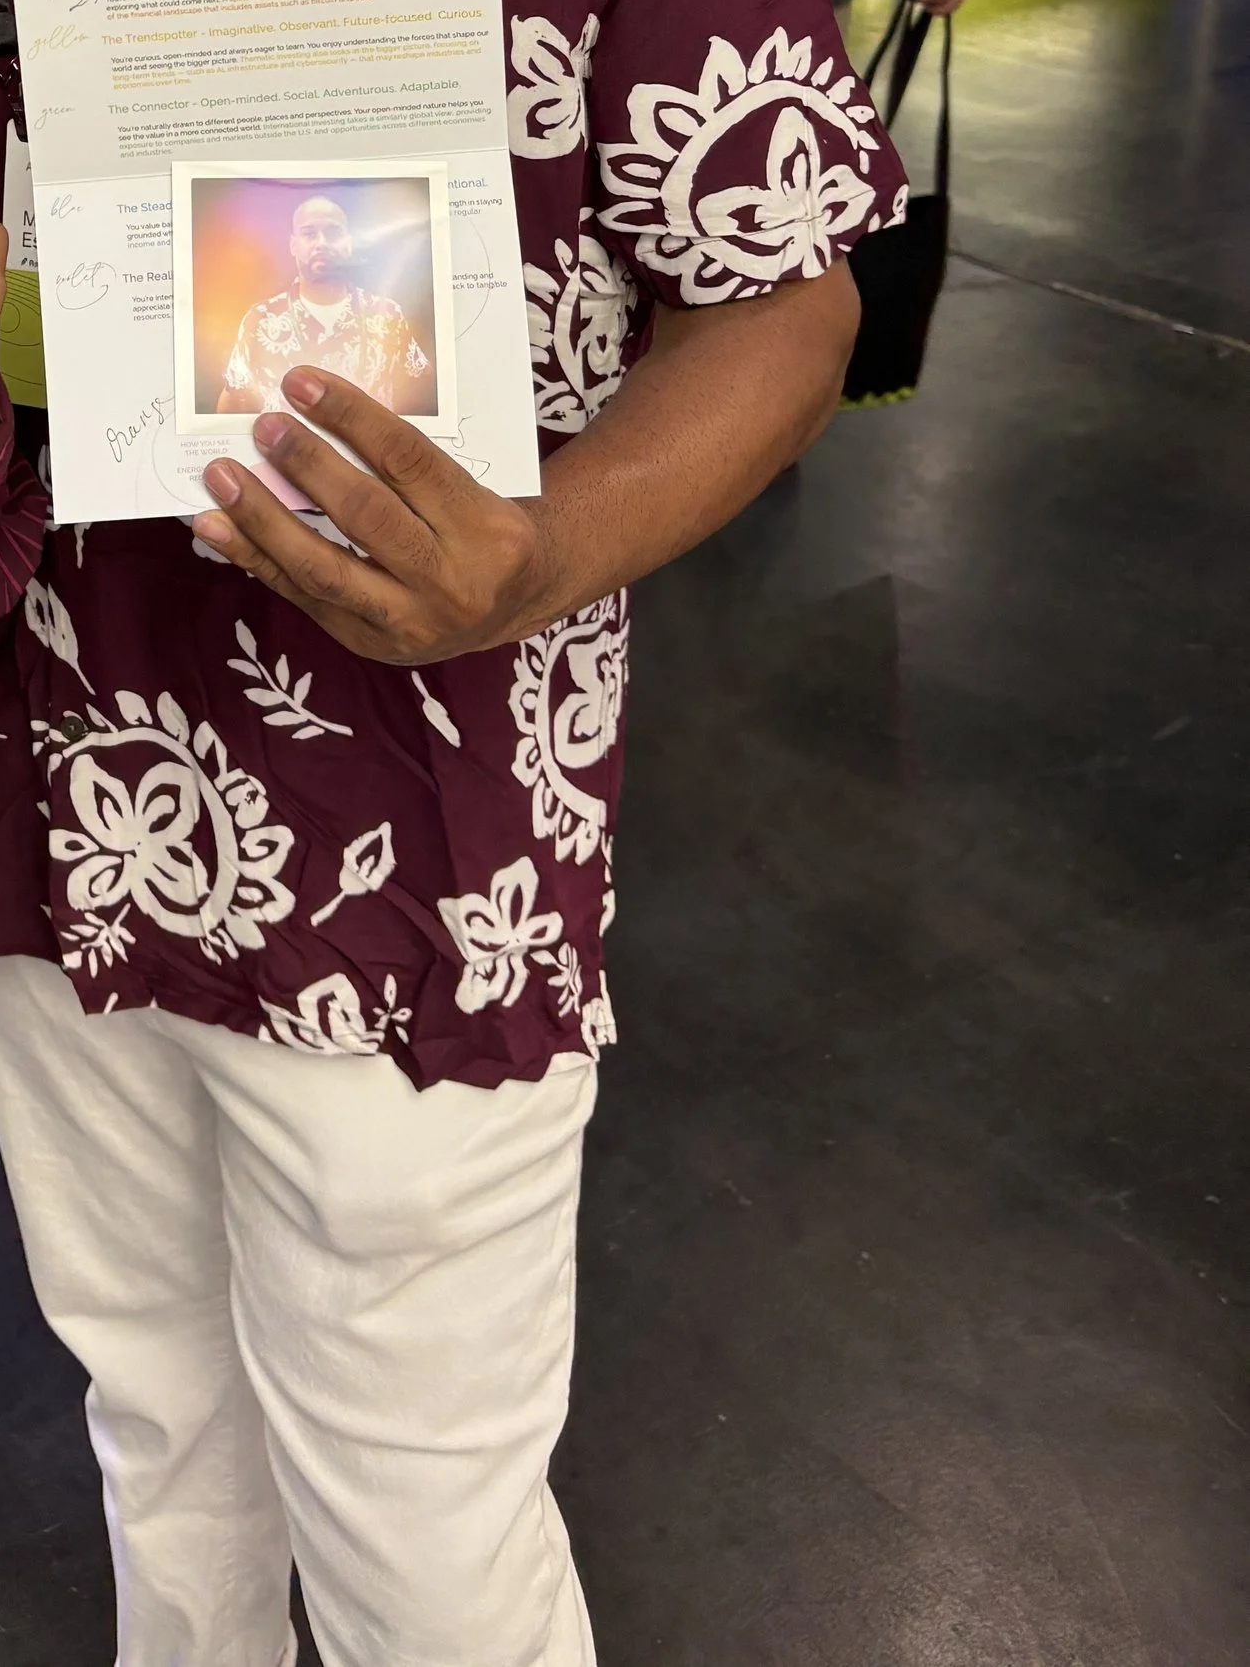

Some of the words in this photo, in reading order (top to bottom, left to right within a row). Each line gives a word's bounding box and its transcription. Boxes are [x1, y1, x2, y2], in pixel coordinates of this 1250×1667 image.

[100, 34, 123, 46] The
[123, 28, 198, 44] Trendspotter
[277, 17, 341, 32] Observant.
[106, 103, 130, 115] The
[130, 98, 190, 113] Connector
[199, 91, 281, 110] Open-minded.
[282, 88, 321, 101] Social.
[321, 84, 398, 98] Adventurous.
[34, 102, 76, 131] green
[476, 198, 503, 206] staying
[117, 204, 138, 214] The
[127, 230, 161, 241] grounded
[128, 241, 155, 249] income
[122, 273, 144, 283] The
[133, 303, 170, 312] appreciate
